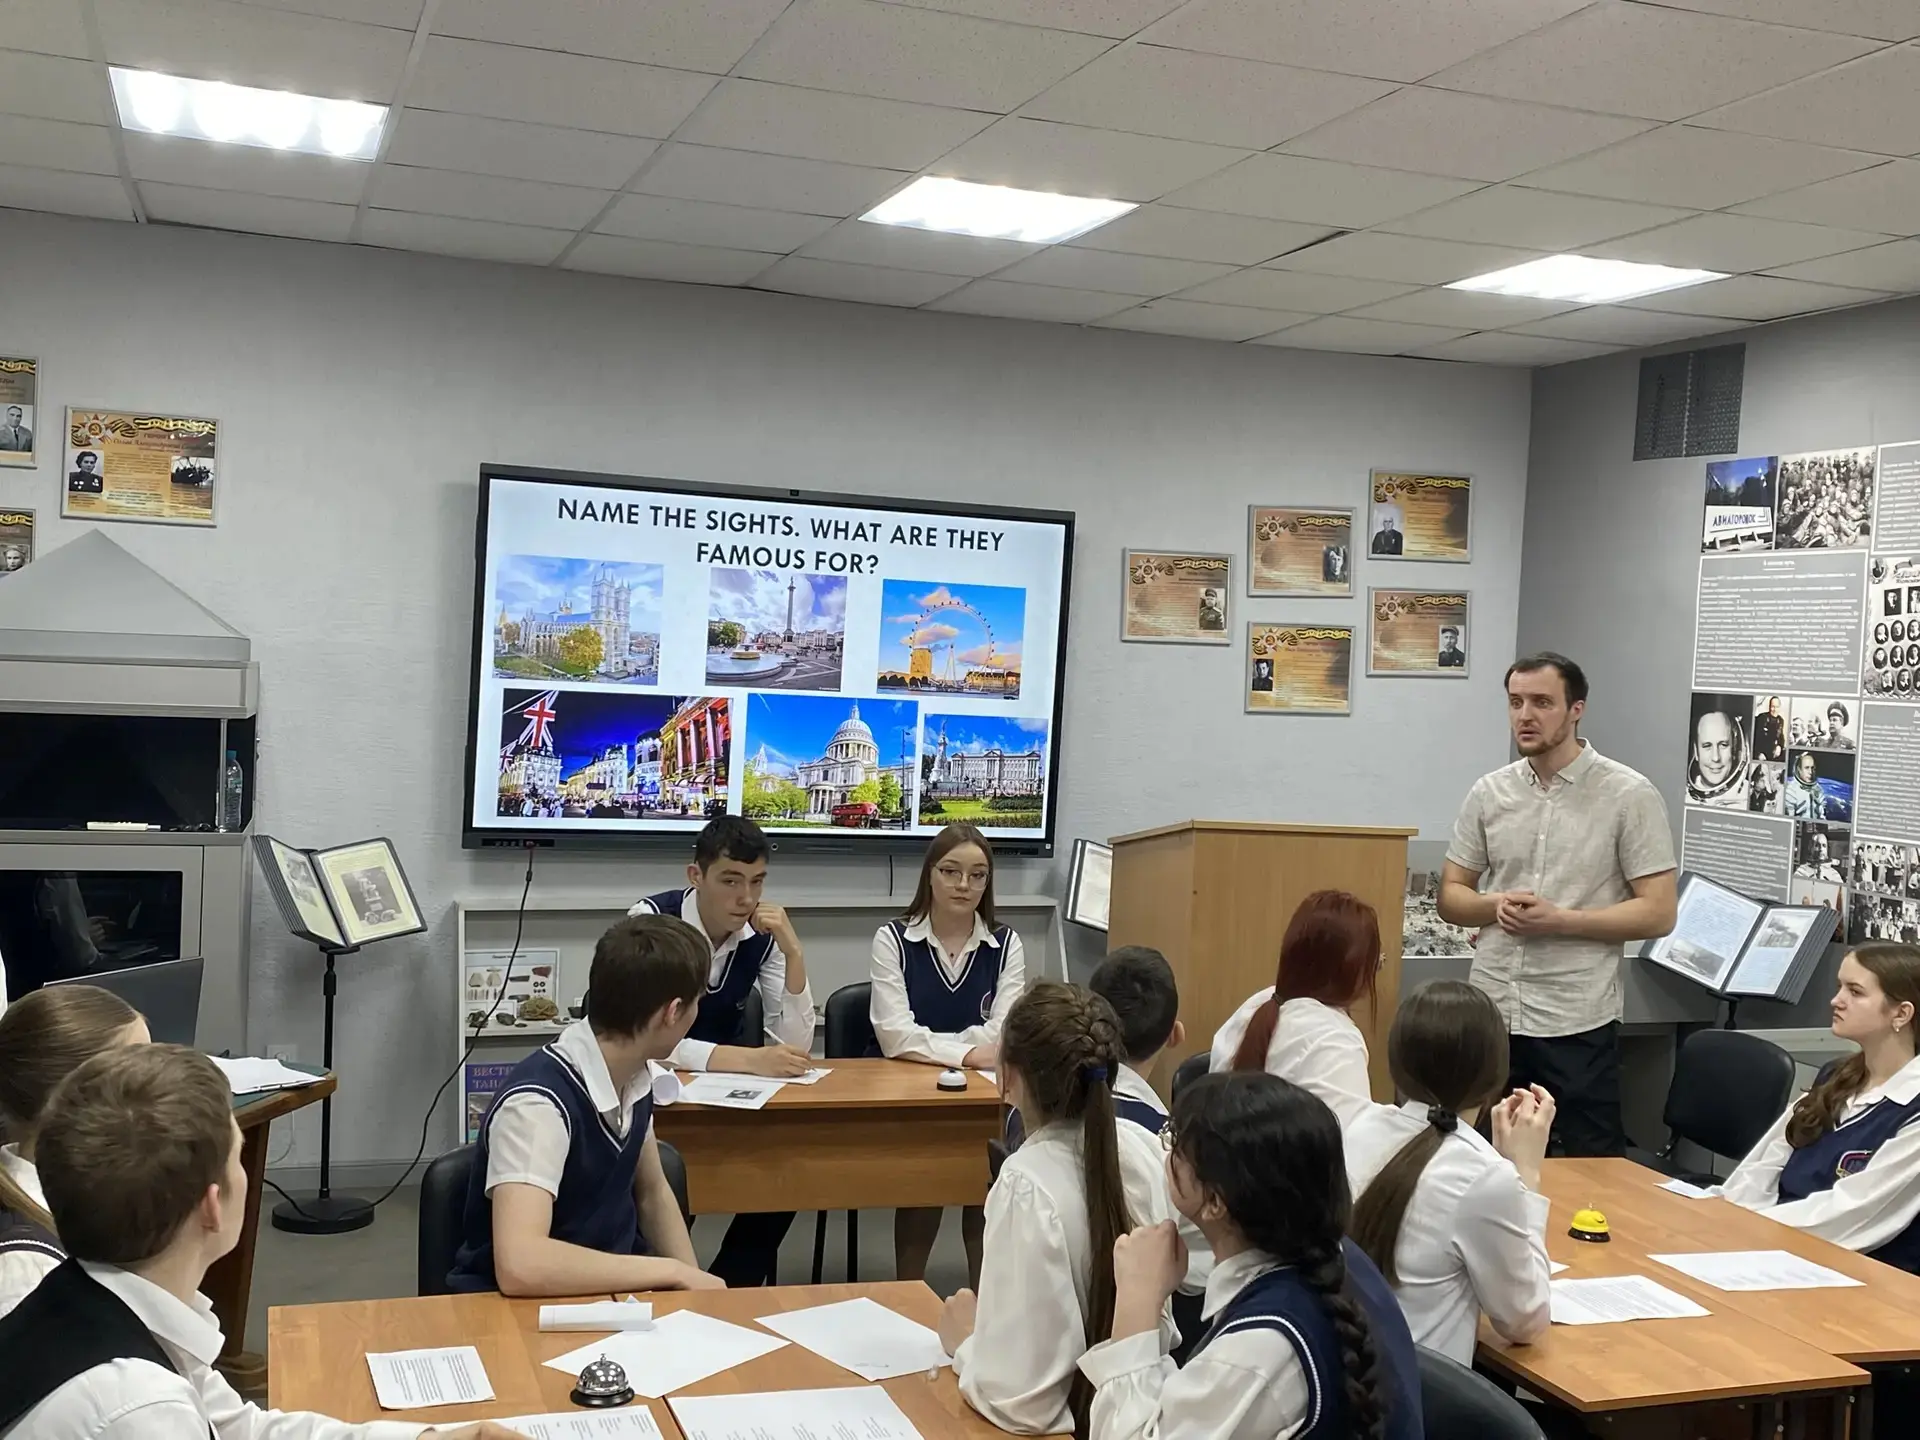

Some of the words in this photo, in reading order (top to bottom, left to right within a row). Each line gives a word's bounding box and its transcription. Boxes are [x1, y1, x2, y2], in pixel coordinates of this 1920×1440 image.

[558, 498, 640, 525] NAME
[650, 505, 697, 529] THE
[705, 509, 800, 537] SIGHTS.
[810, 517, 882, 543] WHAT
[889, 524, 938, 547] ARE
[946, 528, 1005, 552] THEY
[696, 542, 805, 570] FAMOUS
[814, 551, 879, 575] FOR?
